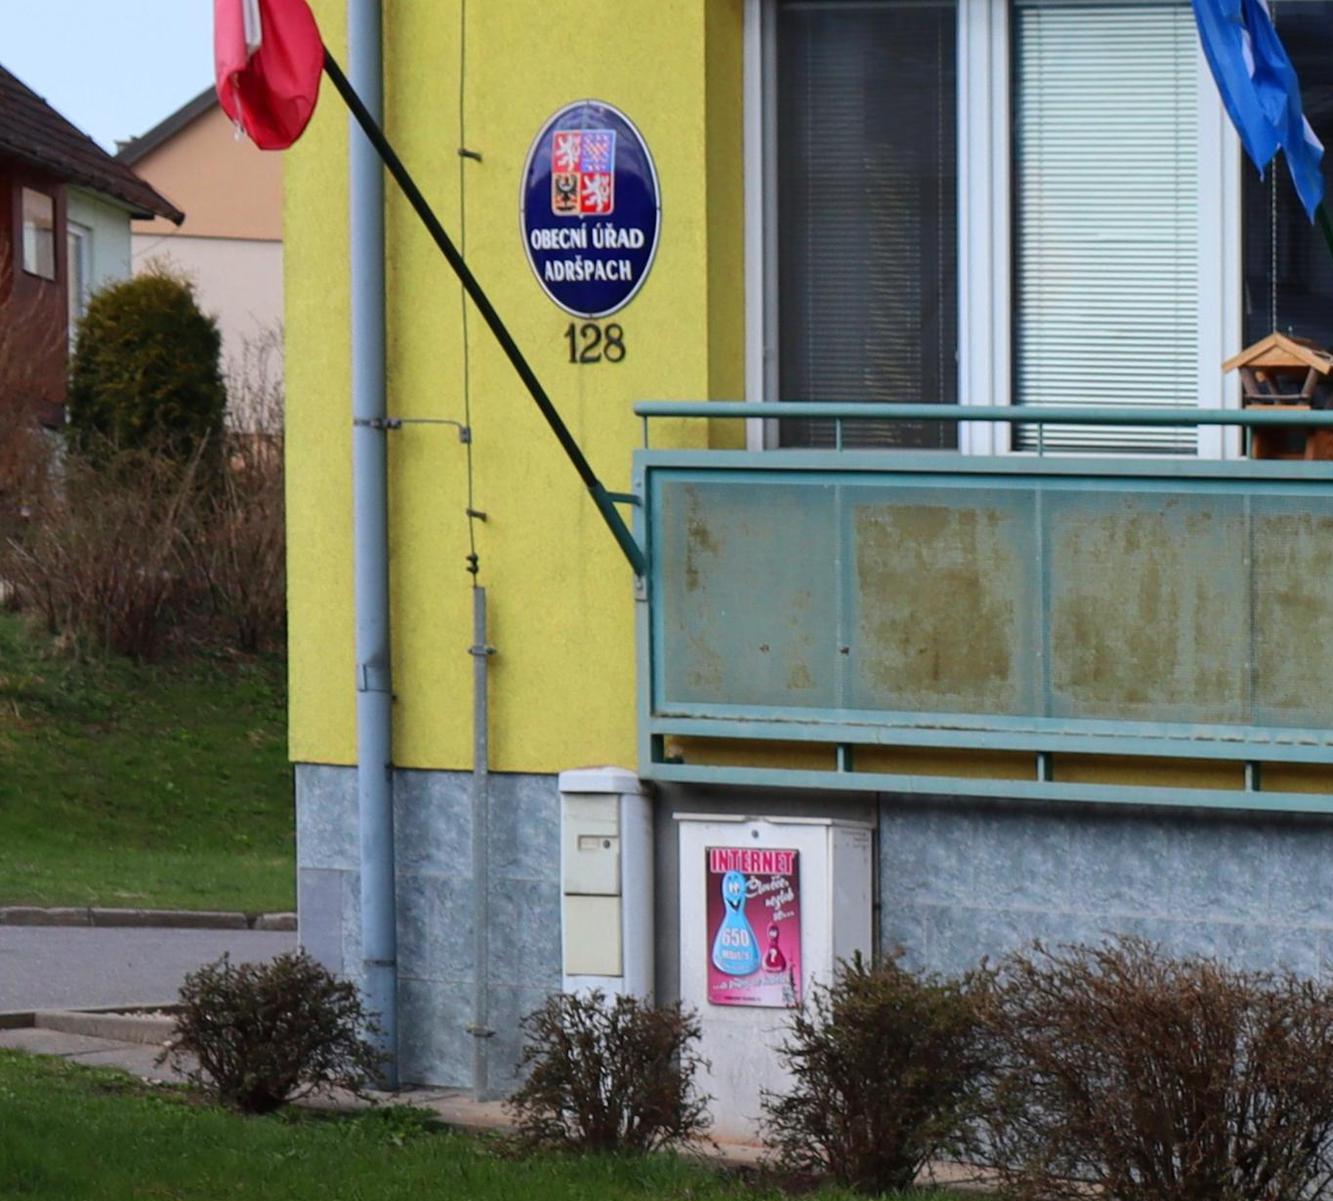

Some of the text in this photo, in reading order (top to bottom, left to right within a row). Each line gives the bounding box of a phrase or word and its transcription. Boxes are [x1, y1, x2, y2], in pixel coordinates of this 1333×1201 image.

[531, 223, 644, 249] OBECNÍ ÚŘAD
[544, 255, 632, 281] ADRŠPACH
[564, 322, 626, 364] 128
[711, 848, 795, 875] INTERNET
[721, 928, 750, 946] 650
